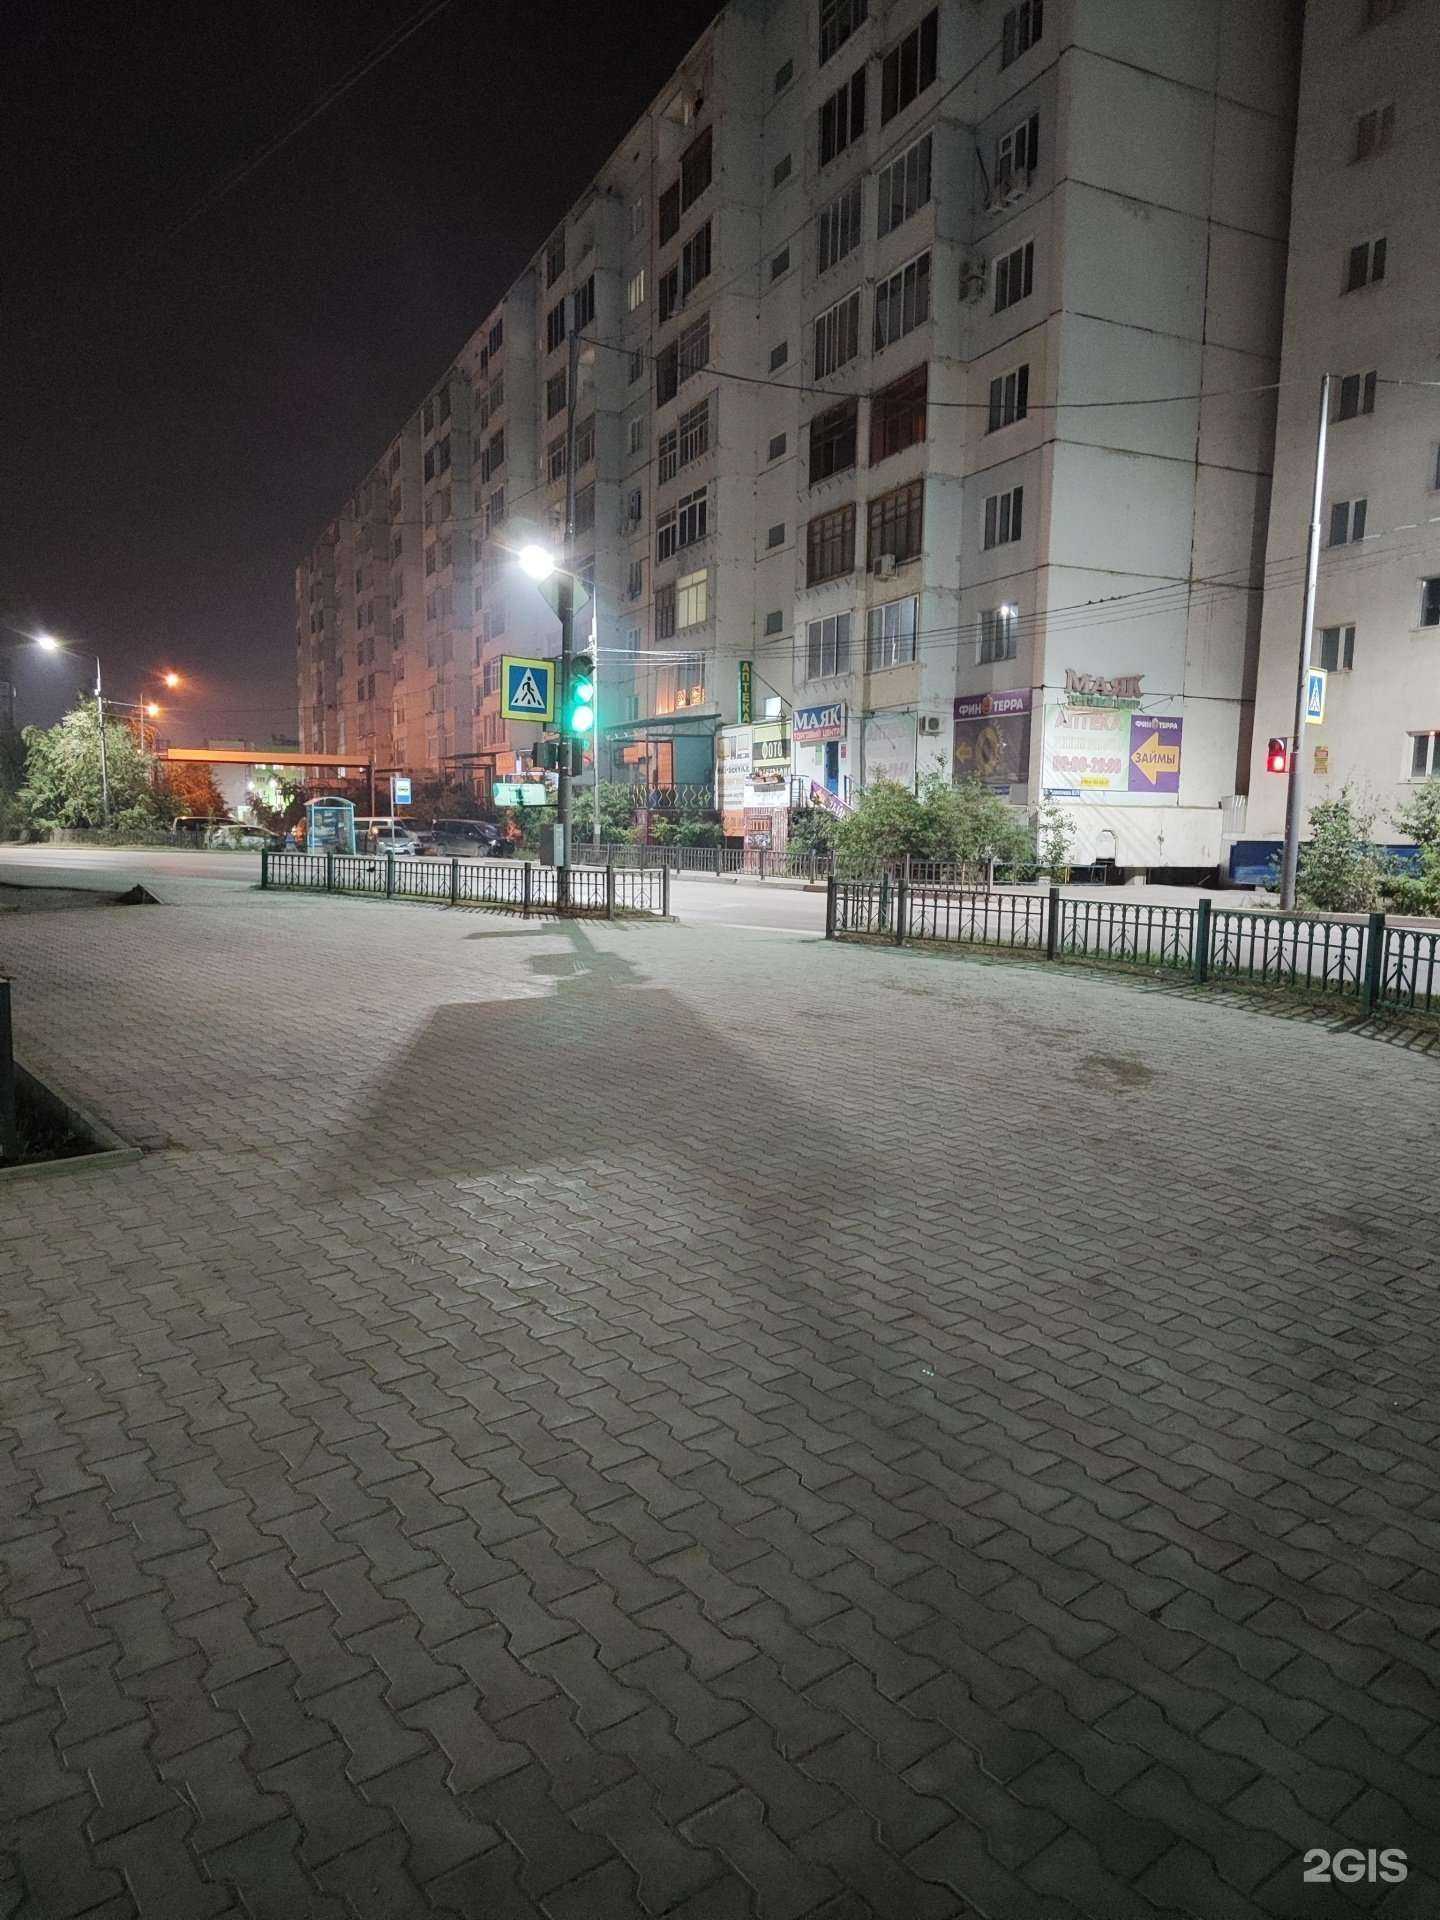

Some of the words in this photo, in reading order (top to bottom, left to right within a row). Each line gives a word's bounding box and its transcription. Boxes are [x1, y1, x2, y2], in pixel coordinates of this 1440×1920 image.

[742, 662, 750, 723] АПТЕКА
[1064, 668, 1145, 698] МАЯК
[793, 705, 841, 730] МАЯК
[959, 704, 981, 716] ФИН
[994, 698, 1023, 712] ТЕРРА
[761, 741, 783, 760] ФОТО
[1135, 750, 1176, 764] ЗАЙМЫ
